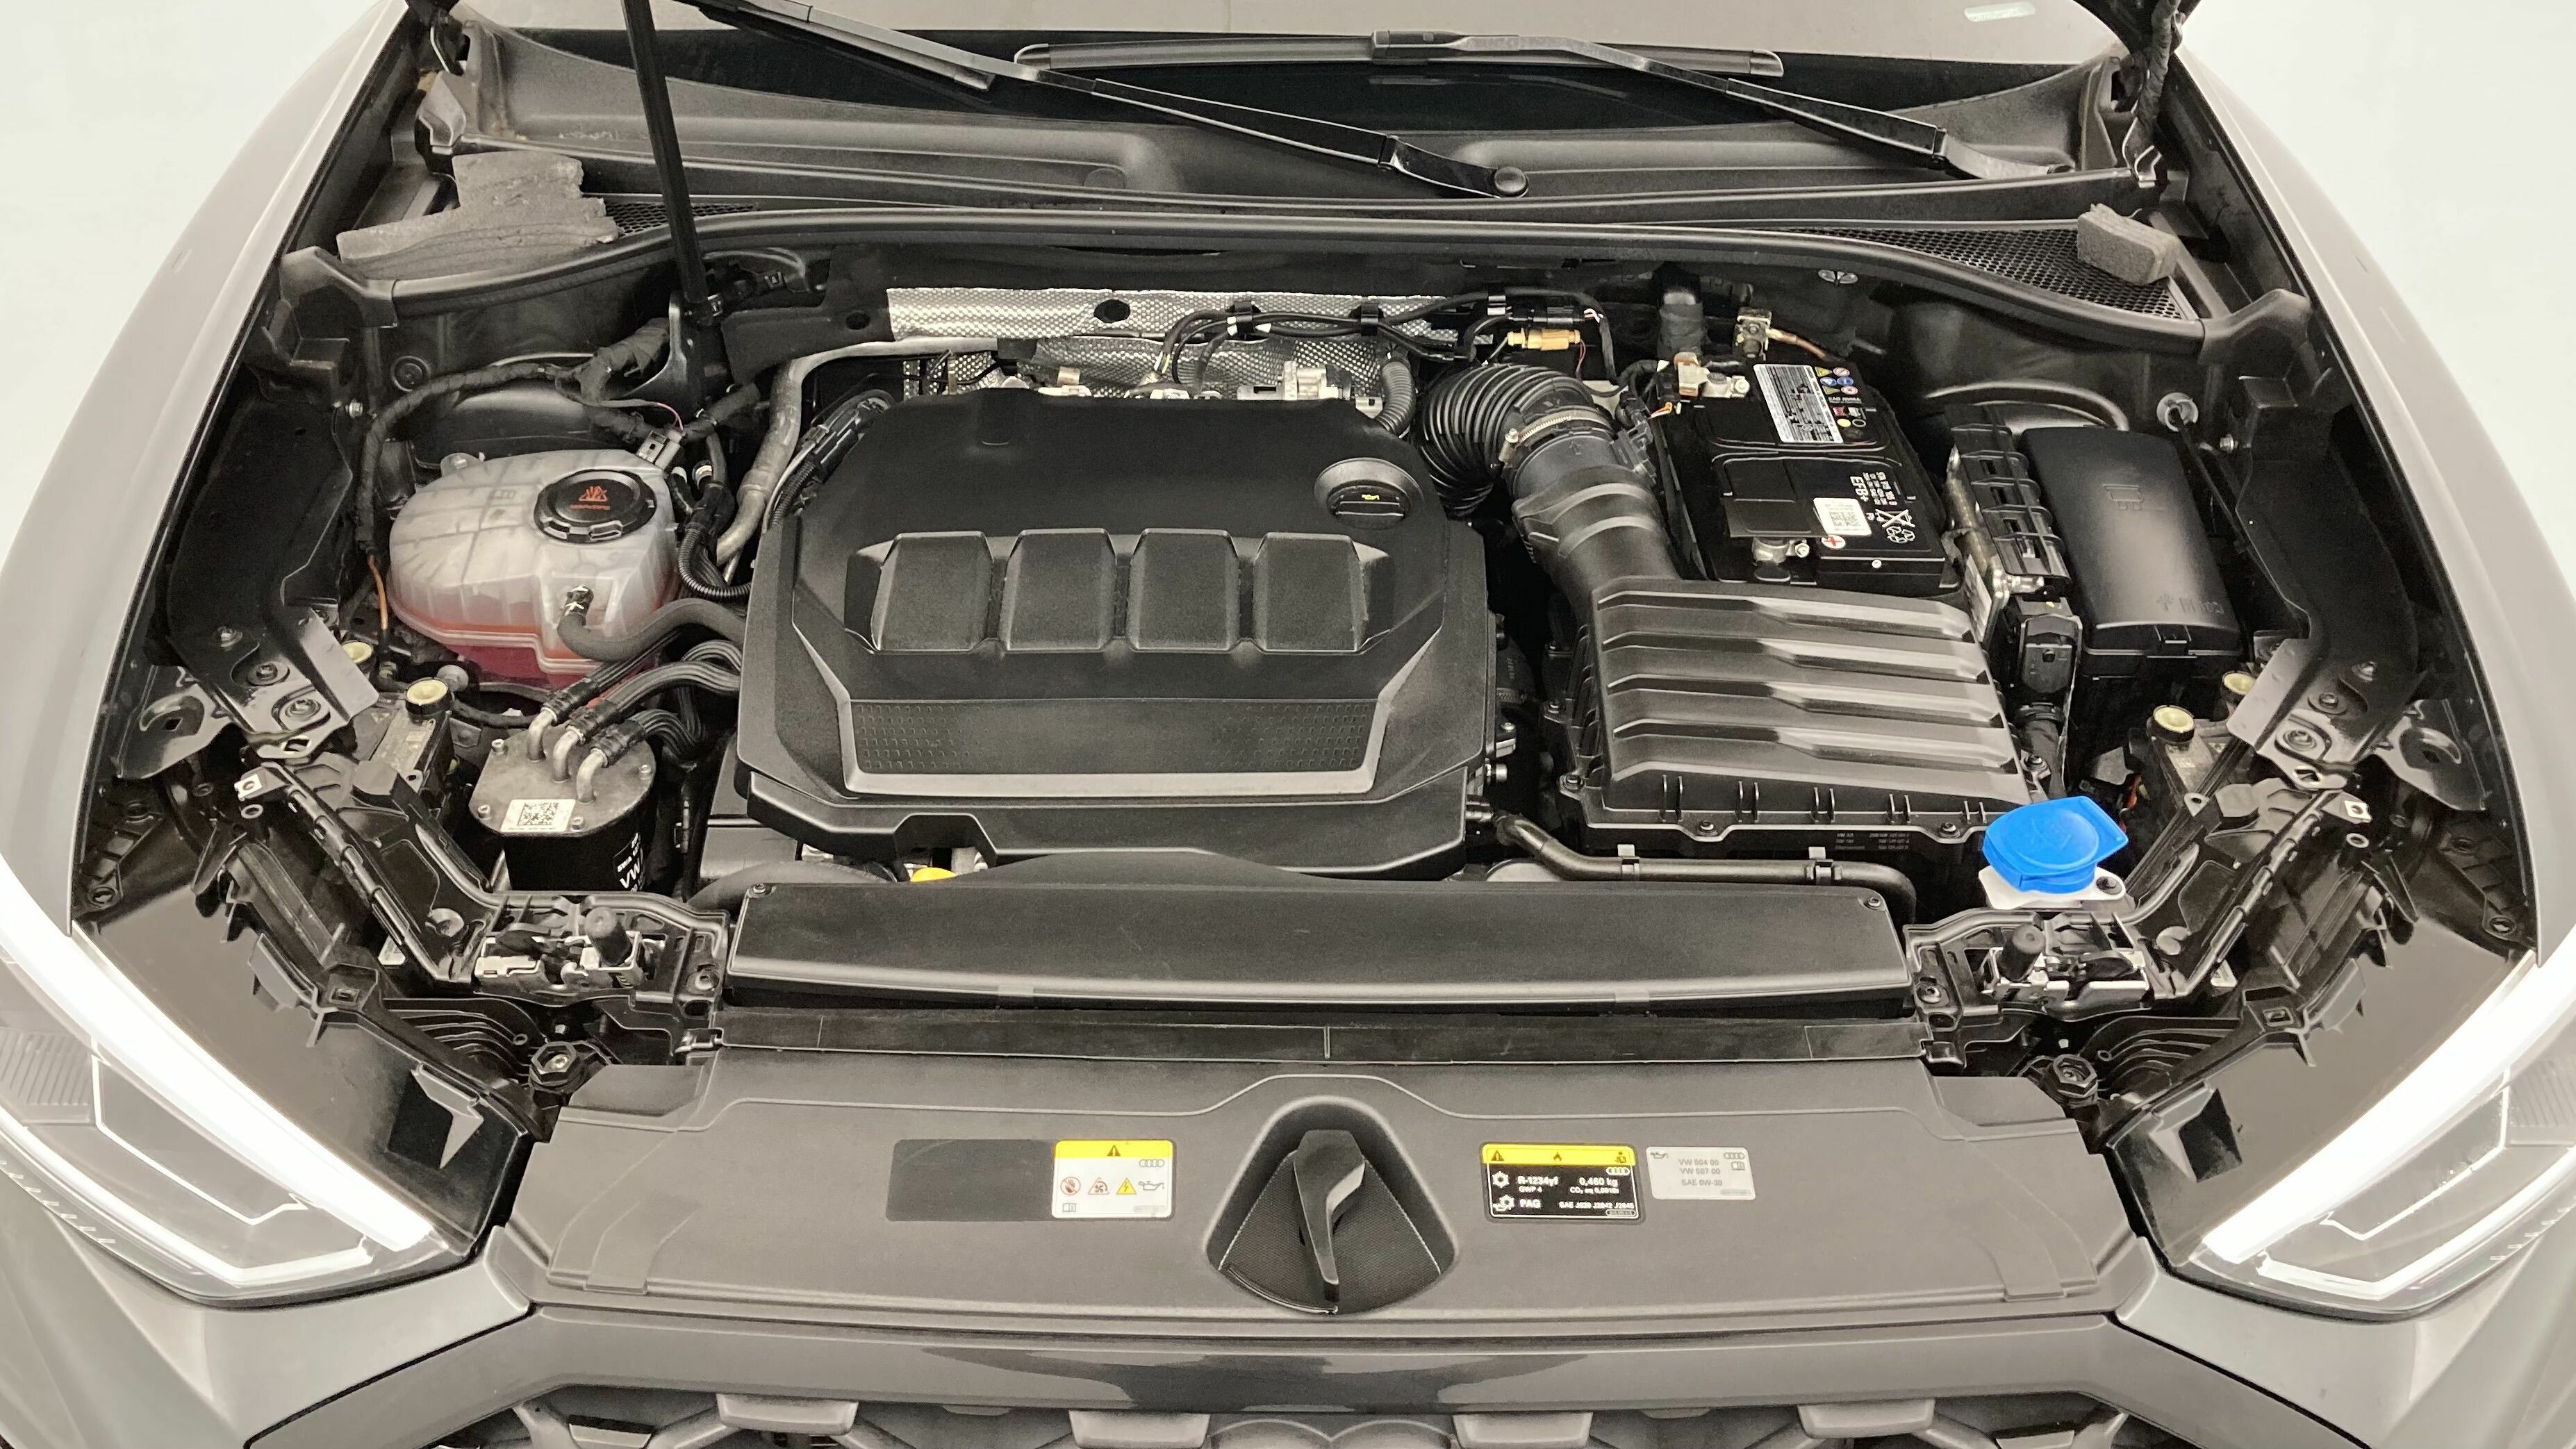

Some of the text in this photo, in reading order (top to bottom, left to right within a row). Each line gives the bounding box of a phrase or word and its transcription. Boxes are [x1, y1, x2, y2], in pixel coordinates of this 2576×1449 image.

[1850, 477, 1869, 502] EFB+
[1517, 1175, 1558, 1186] R-1234yf
[1606, 1177, 1619, 1187] kg
[1519, 1199, 1541, 1208] PAG
